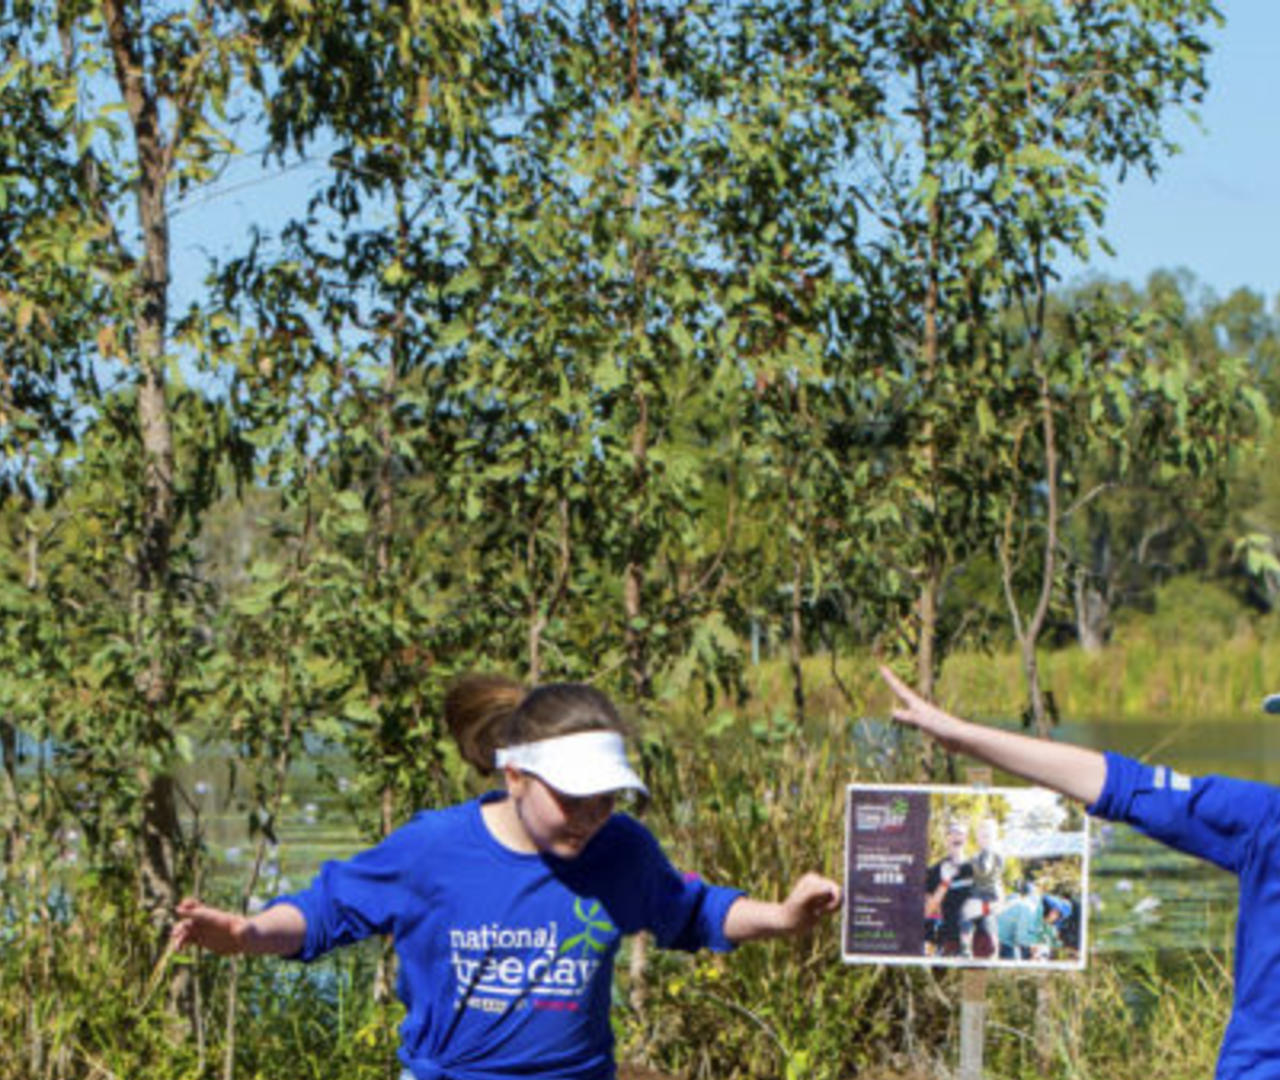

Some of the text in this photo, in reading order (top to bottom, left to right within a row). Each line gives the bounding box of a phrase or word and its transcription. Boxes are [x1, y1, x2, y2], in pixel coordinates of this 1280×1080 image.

[449, 921, 558, 949] national
[451, 949, 600, 996] tree day
